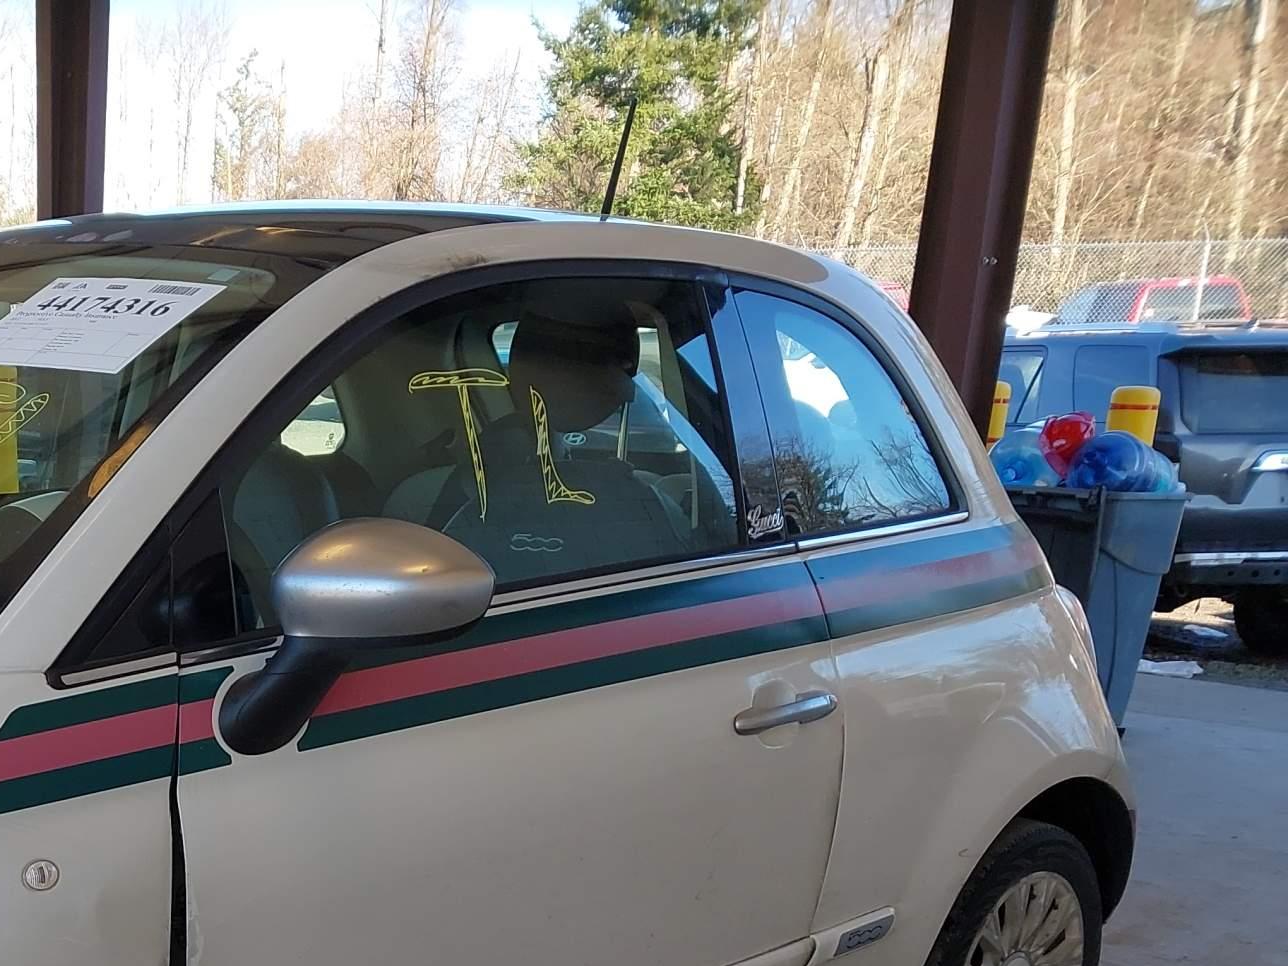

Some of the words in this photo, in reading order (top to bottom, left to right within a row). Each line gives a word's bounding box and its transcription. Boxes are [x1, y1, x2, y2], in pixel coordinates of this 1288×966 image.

[37, 295, 177, 317] 44174316
[747, 503, 784, 539] Gucci
[510, 533, 563, 551] 500
